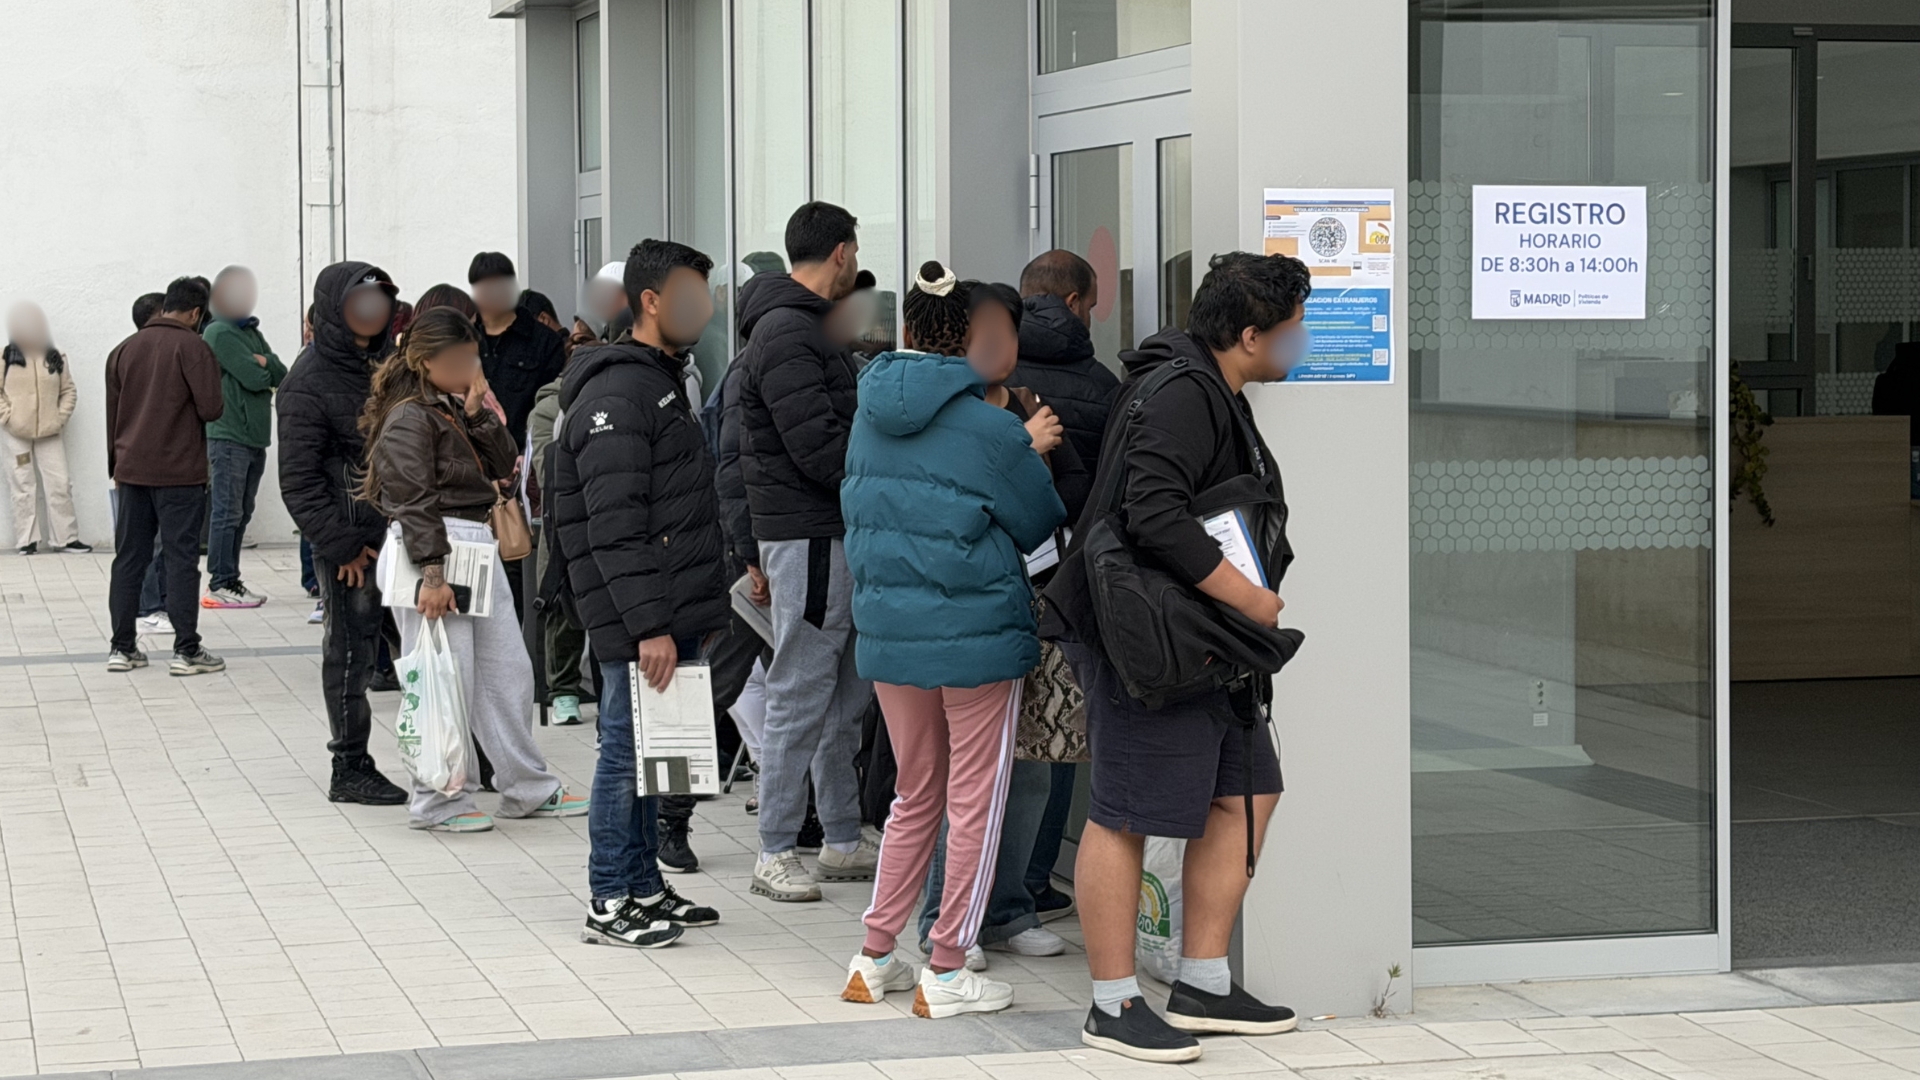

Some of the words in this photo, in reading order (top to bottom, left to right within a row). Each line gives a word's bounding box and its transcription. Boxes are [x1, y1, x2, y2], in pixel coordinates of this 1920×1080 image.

[1495, 202, 1625, 225] REGISTRO
[1520, 233, 1601, 248] HORARIO
[1481, 257, 1504, 272] DE
[1510, 257, 1559, 272] 8:30h
[1565, 261, 1574, 272] a
[1580, 258, 1638, 272] 14:00h
[1524, 294, 1570, 306] MADRID
[590, 424, 614, 434] KELME
[660, 899, 676, 910] N
[612, 919, 629, 931] N
